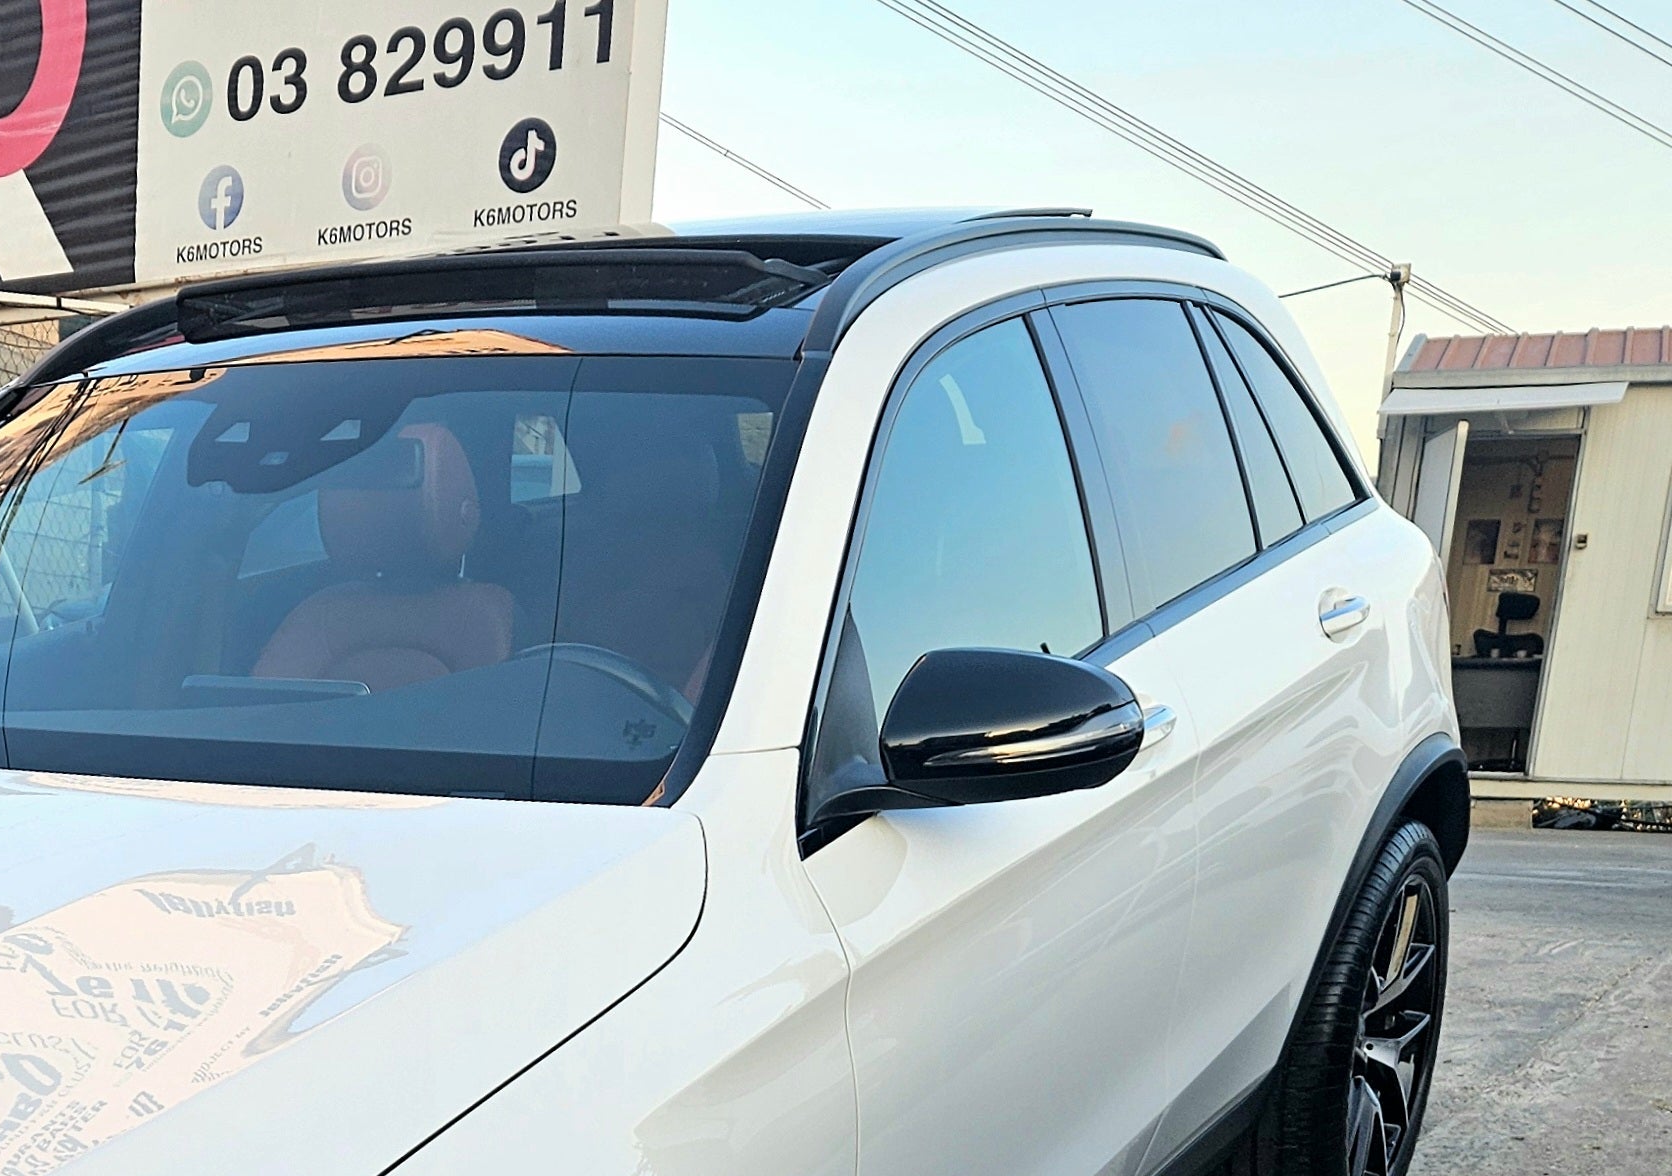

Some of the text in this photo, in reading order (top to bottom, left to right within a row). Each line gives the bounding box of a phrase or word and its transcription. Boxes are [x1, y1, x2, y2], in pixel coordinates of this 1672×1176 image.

[227, 0, 614, 122] 03 829911
[473, 200, 578, 229] K6MOTORS
[317, 218, 413, 247] K6MOTORS
[176, 237, 264, 264] K6MOTORS
